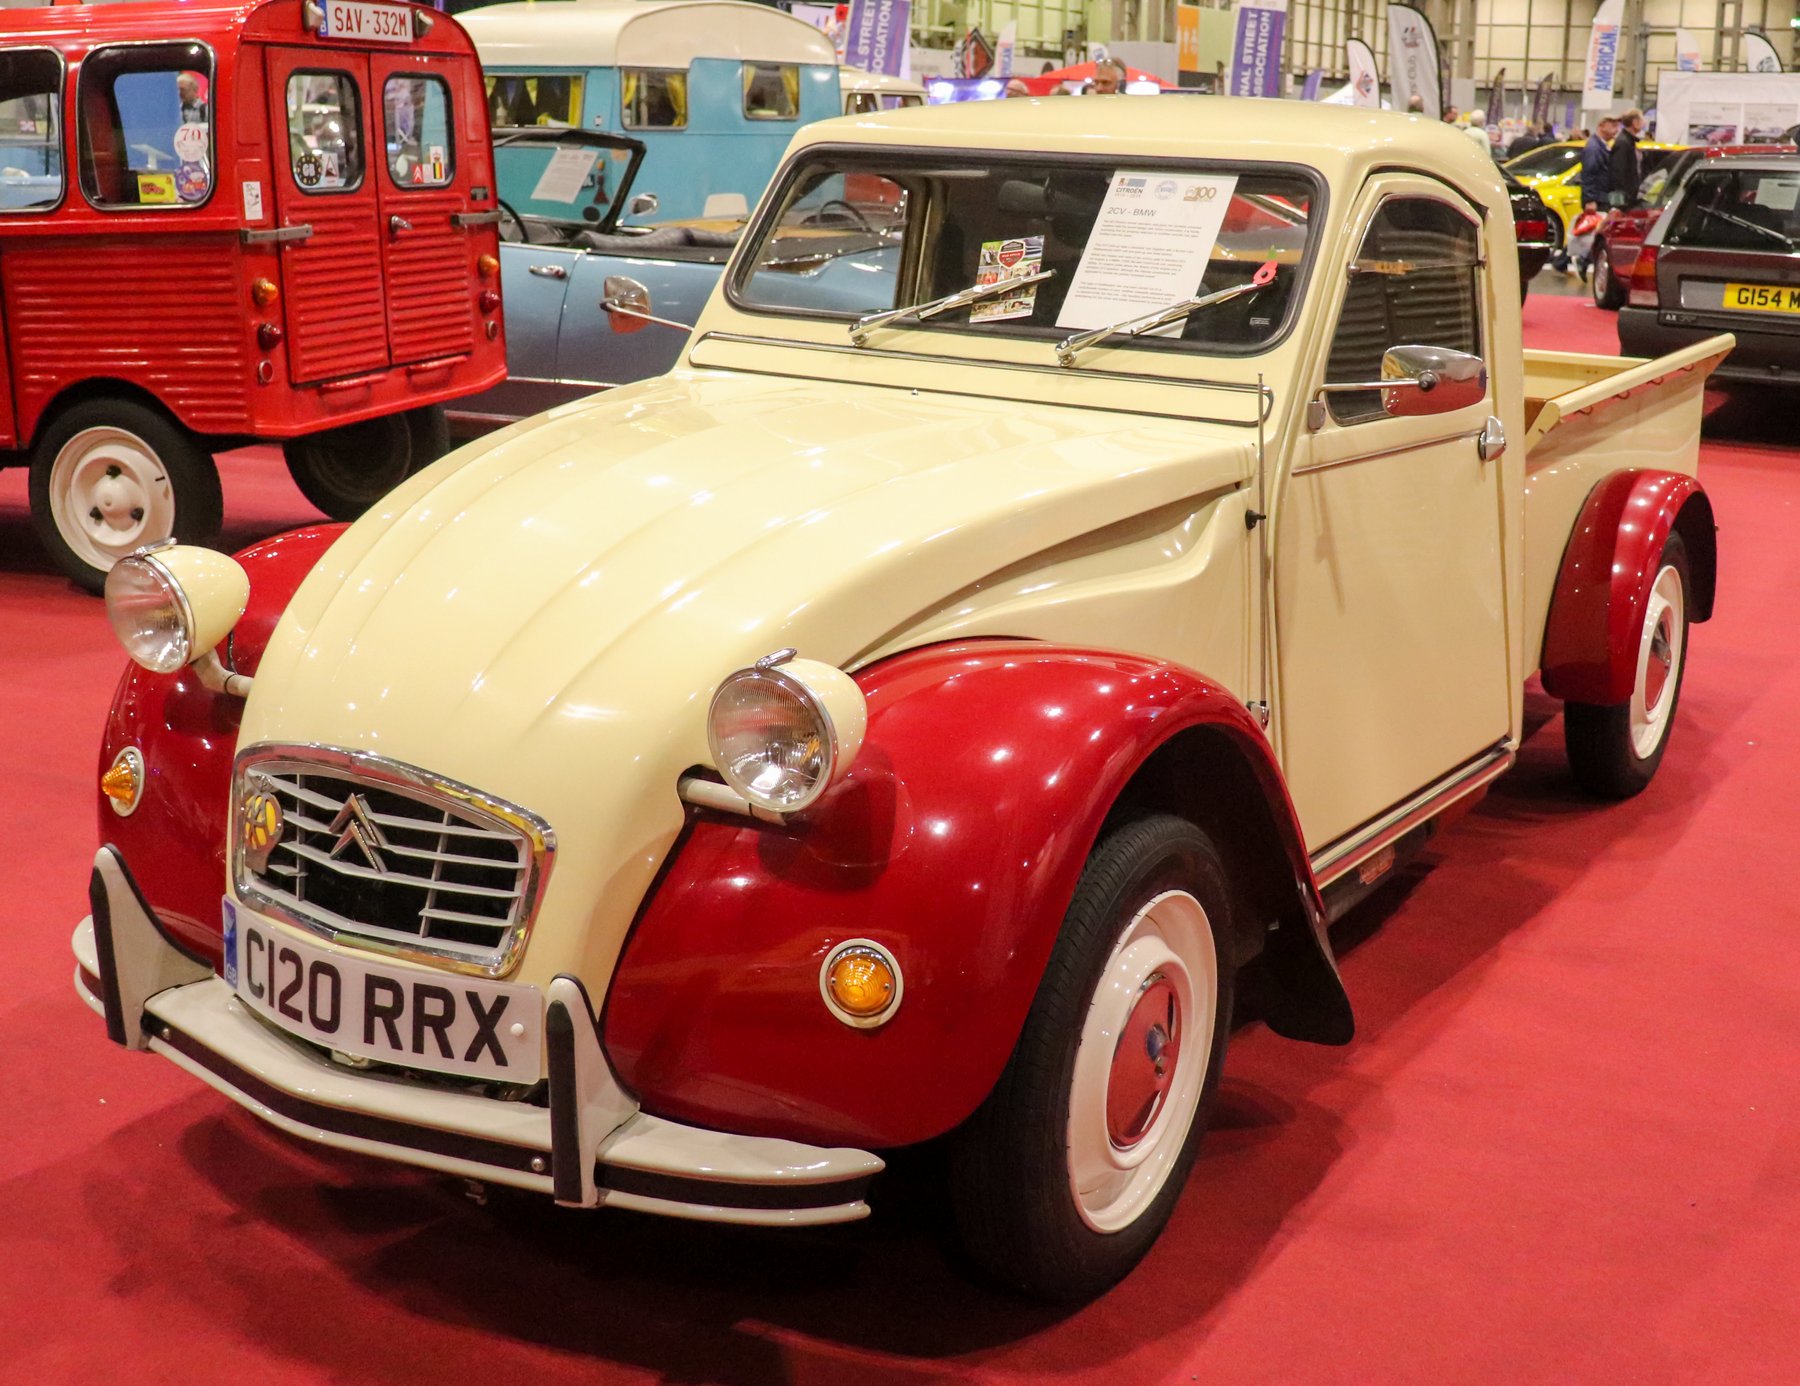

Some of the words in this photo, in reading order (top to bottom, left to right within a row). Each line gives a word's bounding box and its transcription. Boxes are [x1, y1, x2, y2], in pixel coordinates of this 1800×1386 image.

[858, 0, 876, 55] STREET
[1242, 12, 1258, 65] STREET
[1253, 11, 1271, 97] SSOCIATION
[1593, 31, 1618, 91] AMERICAN
[181, 129, 202, 141] 70
[1107, 207, 1127, 216] 2CV
[1133, 209, 1157, 217] BMW
[1737, 288, 1782, 307] G154
[226, 965, 237, 985] GB
[246, 927, 342, 1034] C120
[363, 973, 510, 1067] RRX
